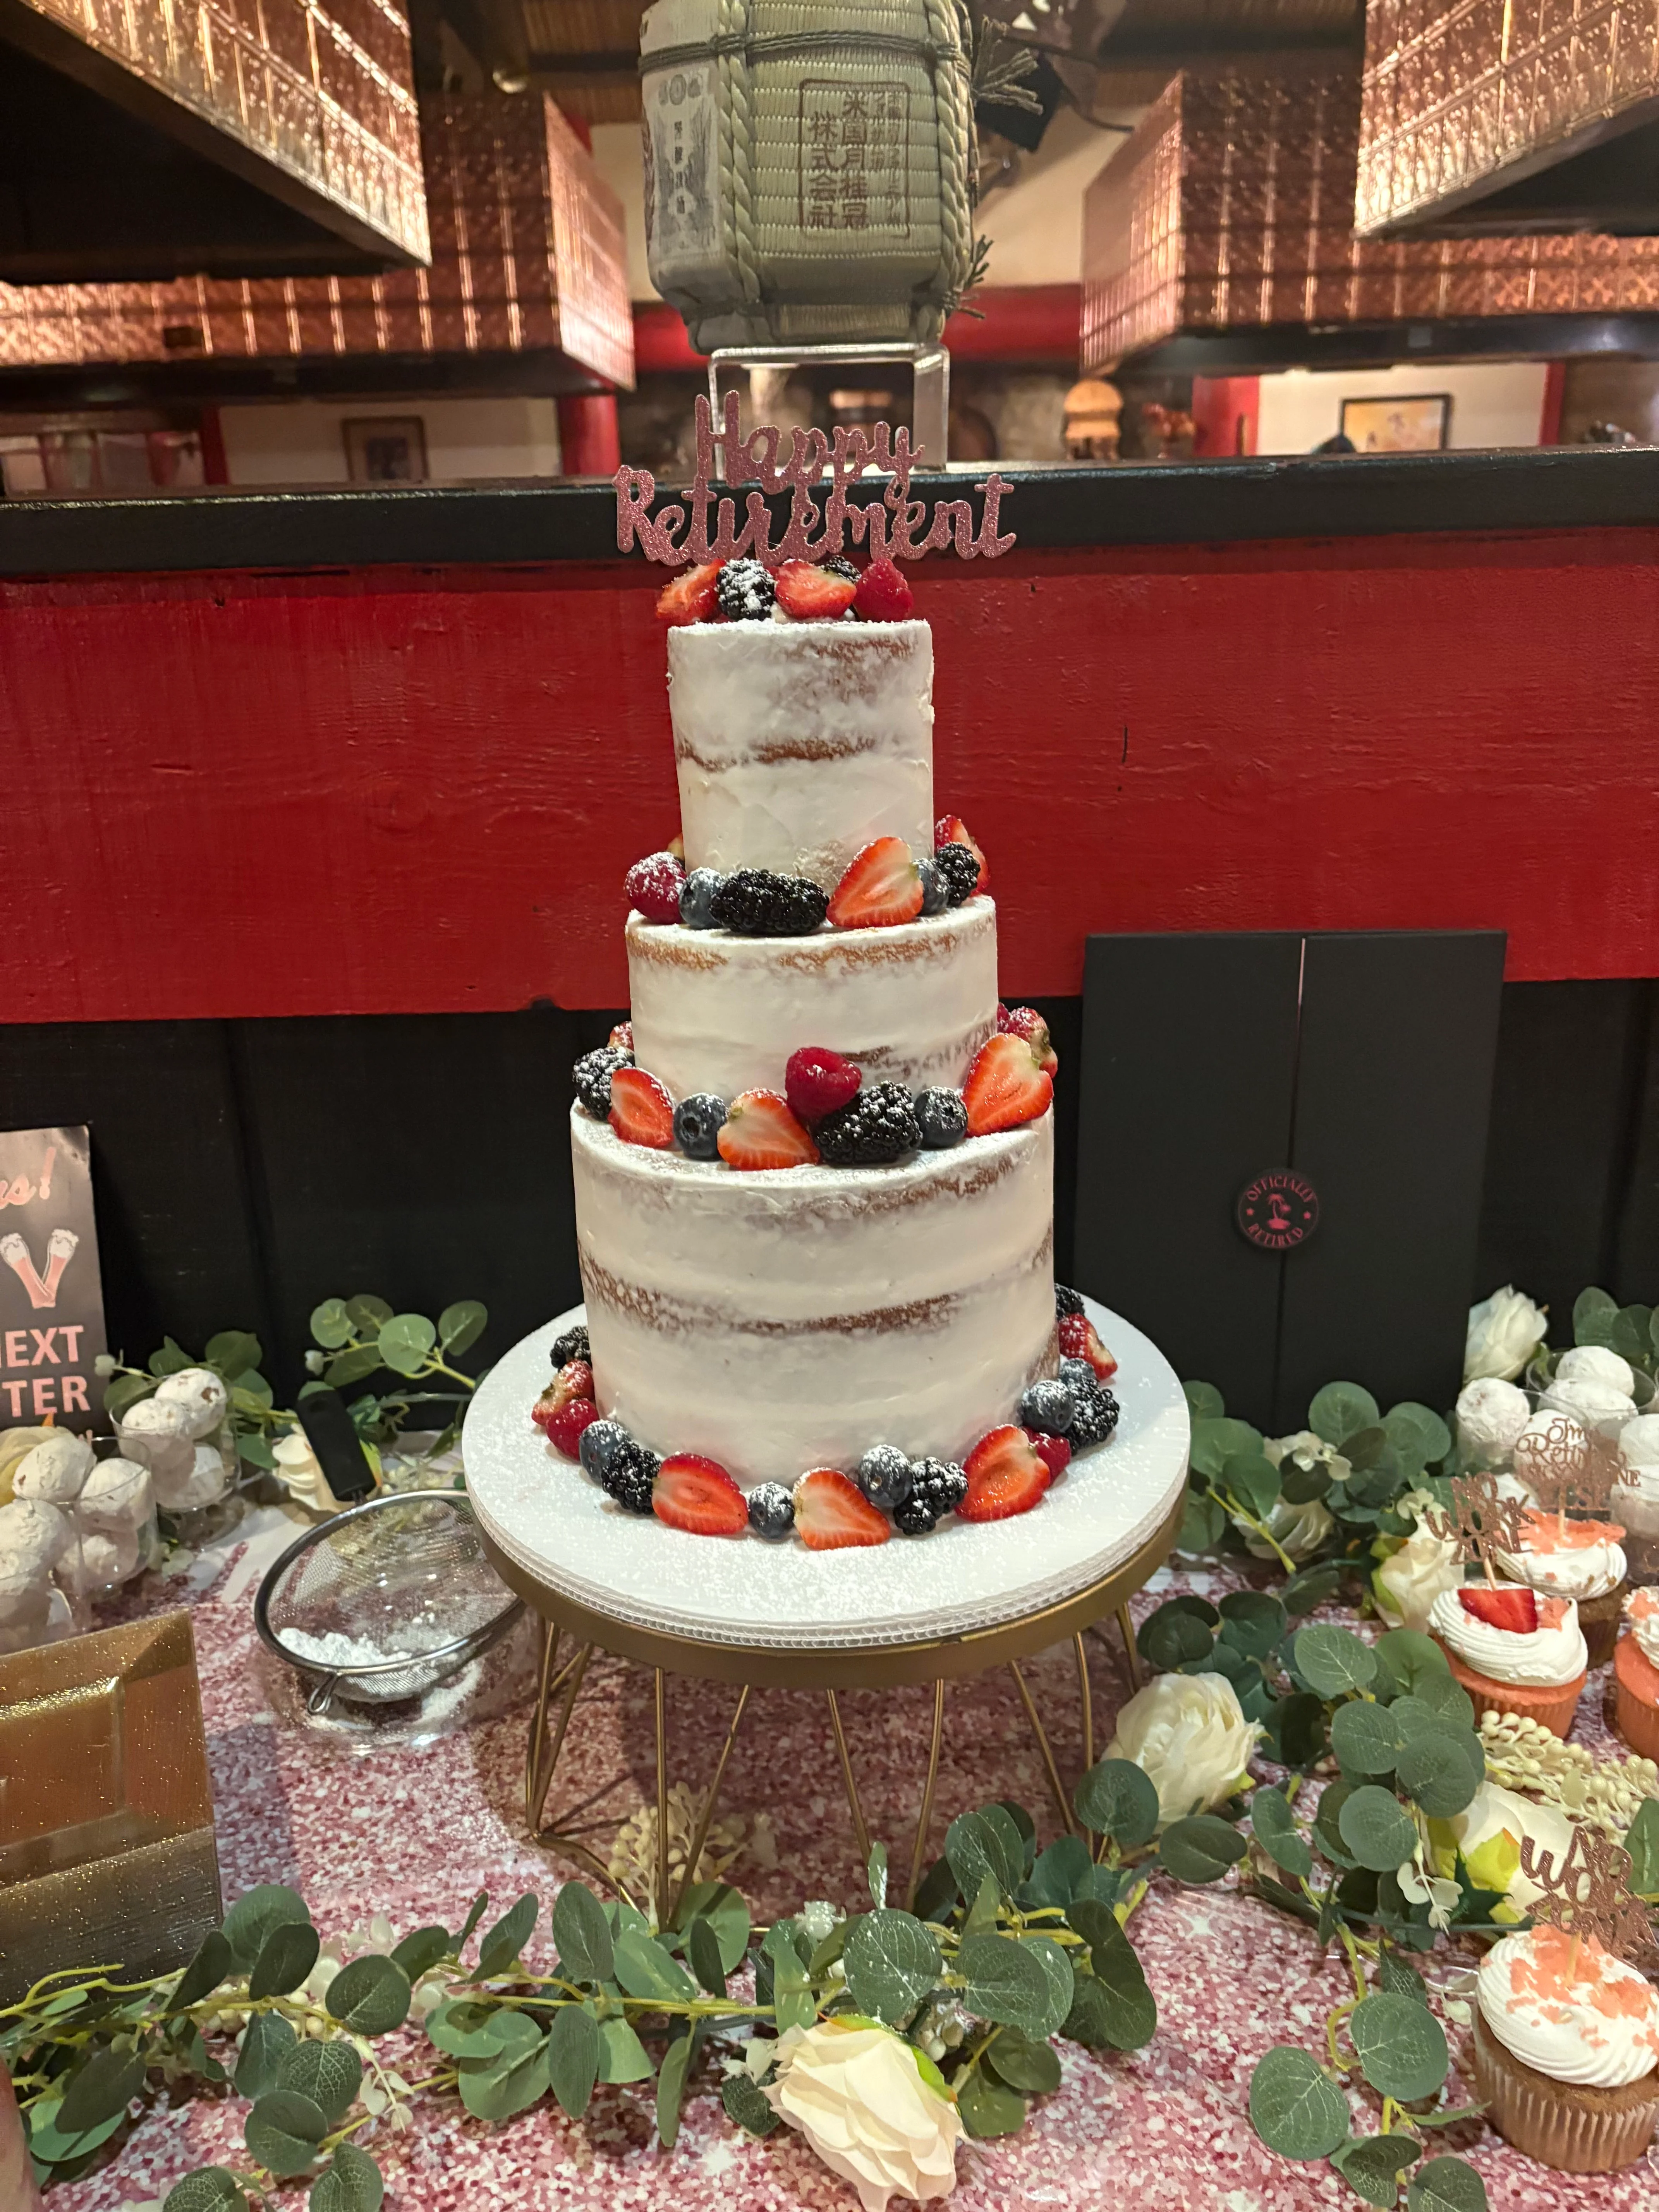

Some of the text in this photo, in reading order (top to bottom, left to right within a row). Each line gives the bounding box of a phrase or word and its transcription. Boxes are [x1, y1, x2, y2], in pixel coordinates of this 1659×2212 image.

[807, 110, 839, 229] 株式会社
[695, 389, 926, 510] Happy
[612, 465, 1017, 566] Retirement
[1246, 1175, 1315, 1203] OFFICIALLY
[1247, 1223, 1304, 1247] RETIRED
[0, 1325, 84, 1369] EXT
